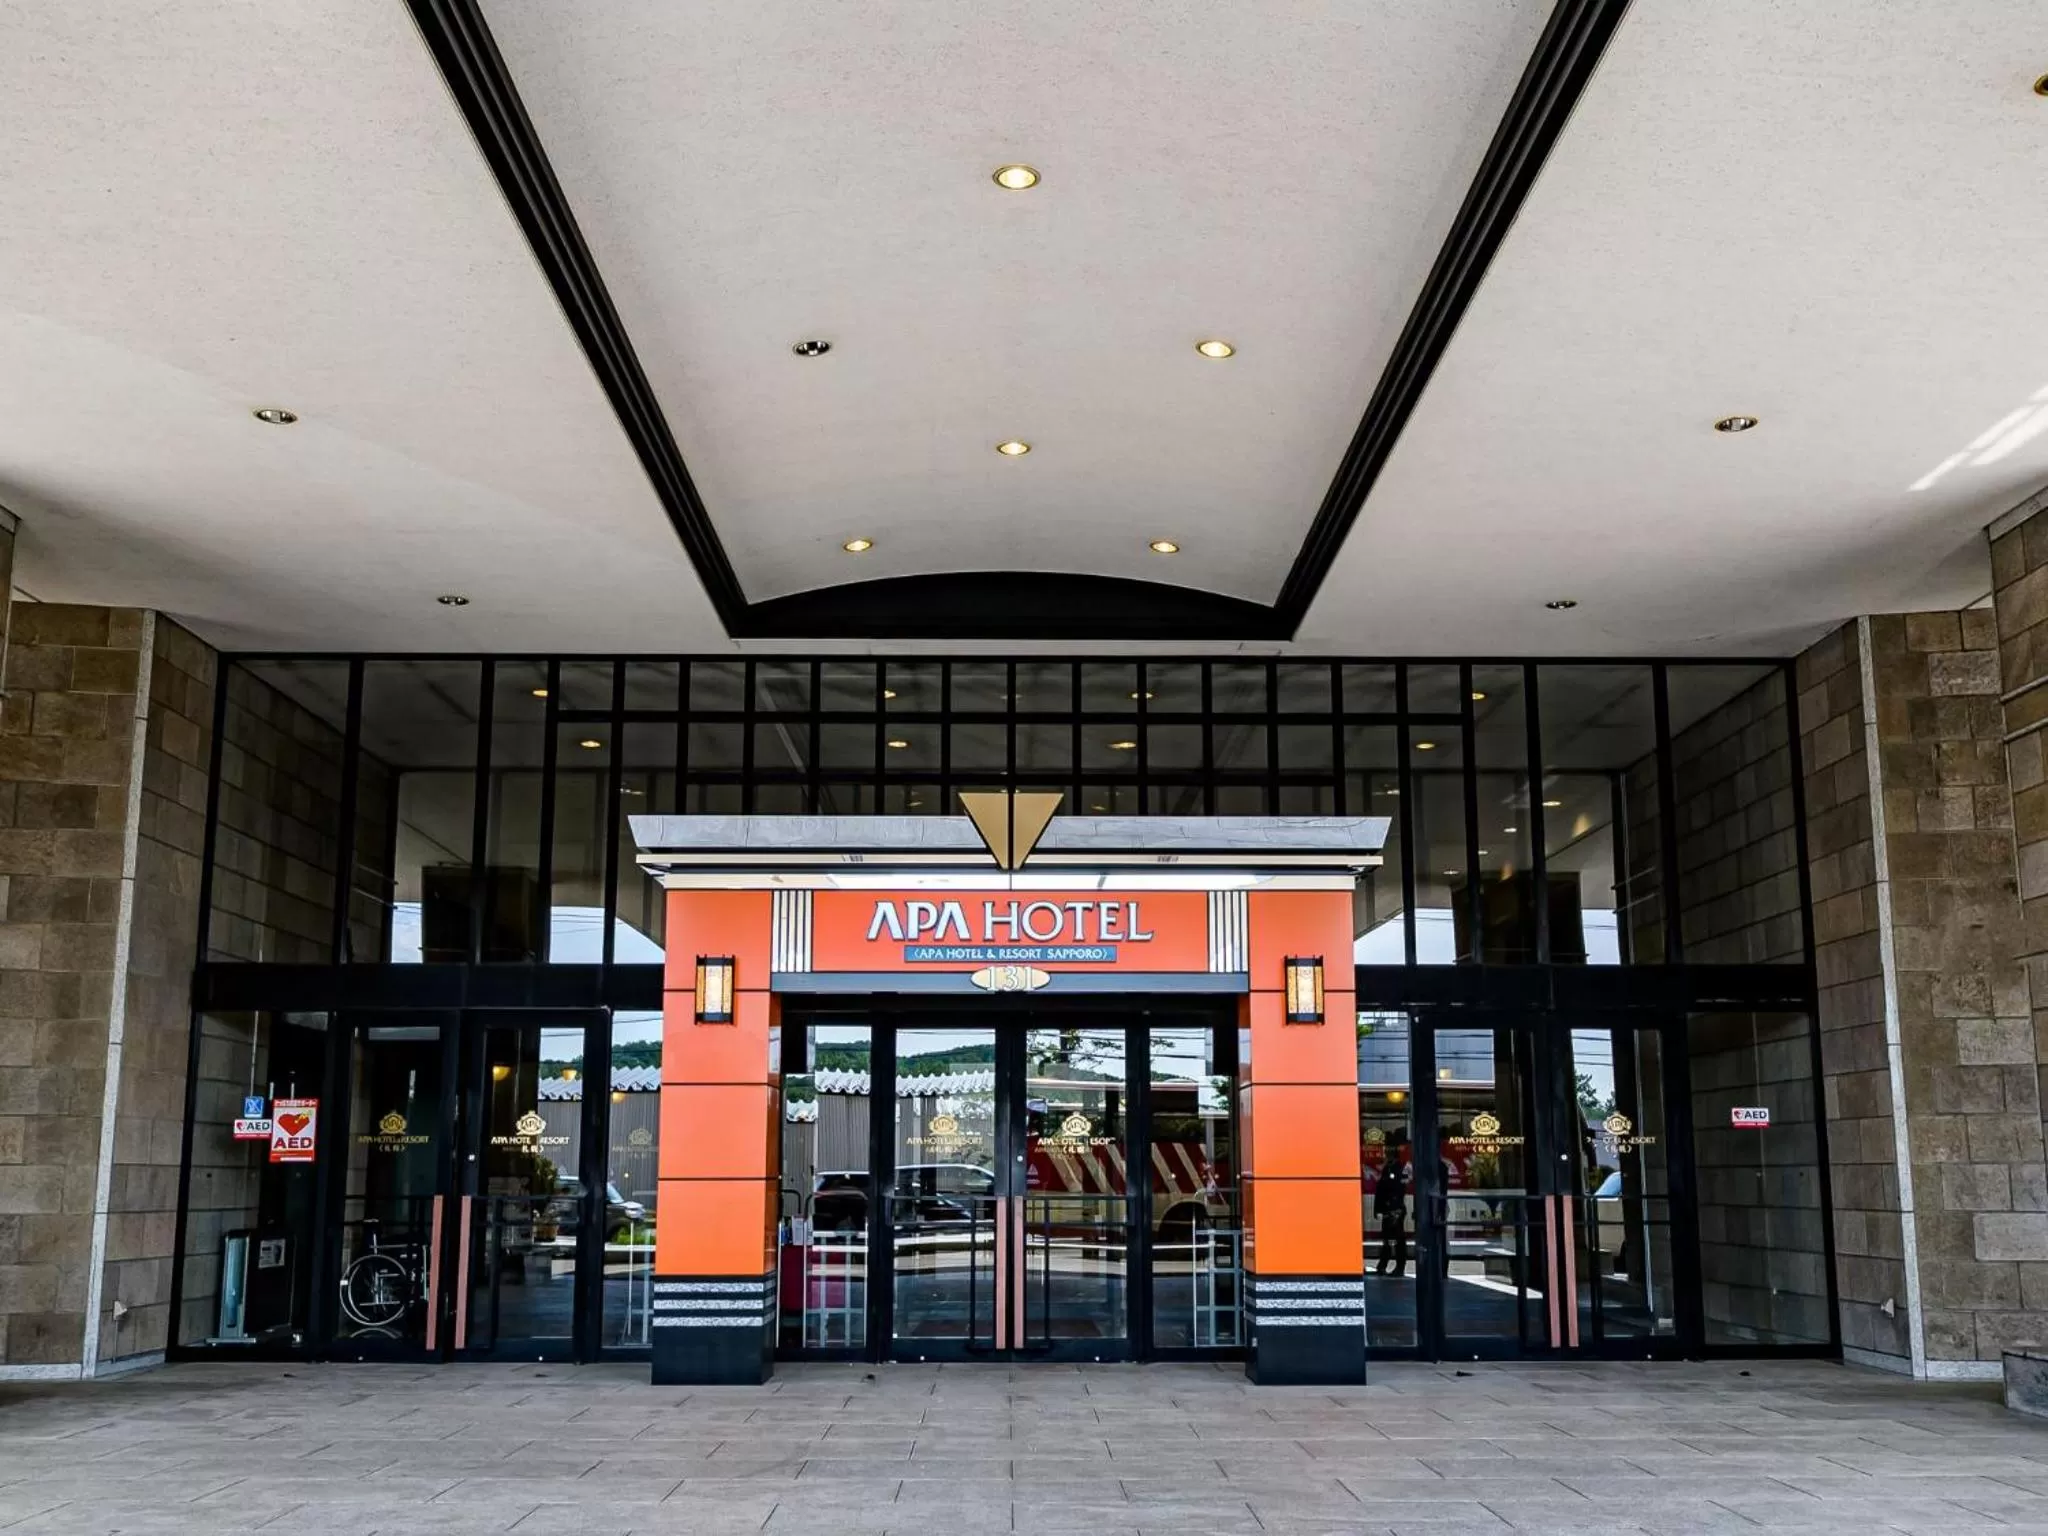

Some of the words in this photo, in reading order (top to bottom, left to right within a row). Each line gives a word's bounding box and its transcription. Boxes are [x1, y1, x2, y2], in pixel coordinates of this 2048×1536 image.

[865, 900, 971, 942] APA
[982, 900, 1155, 942] HOTEL
[946, 948, 983, 960] HOTEL
[986, 948, 996, 960] &
[999, 948, 1042, 960] RESORT
[985, 966, 1035, 993] 131
[1744, 1110, 1768, 1120] AED
[246, 1121, 271, 1131] AED
[273, 1136, 313, 1150] AED
[1449, 1136, 1466, 1145] APA
[1466, 1136, 1489, 1145] HOTEL
[1495, 1136, 1525, 1145] RESORT
